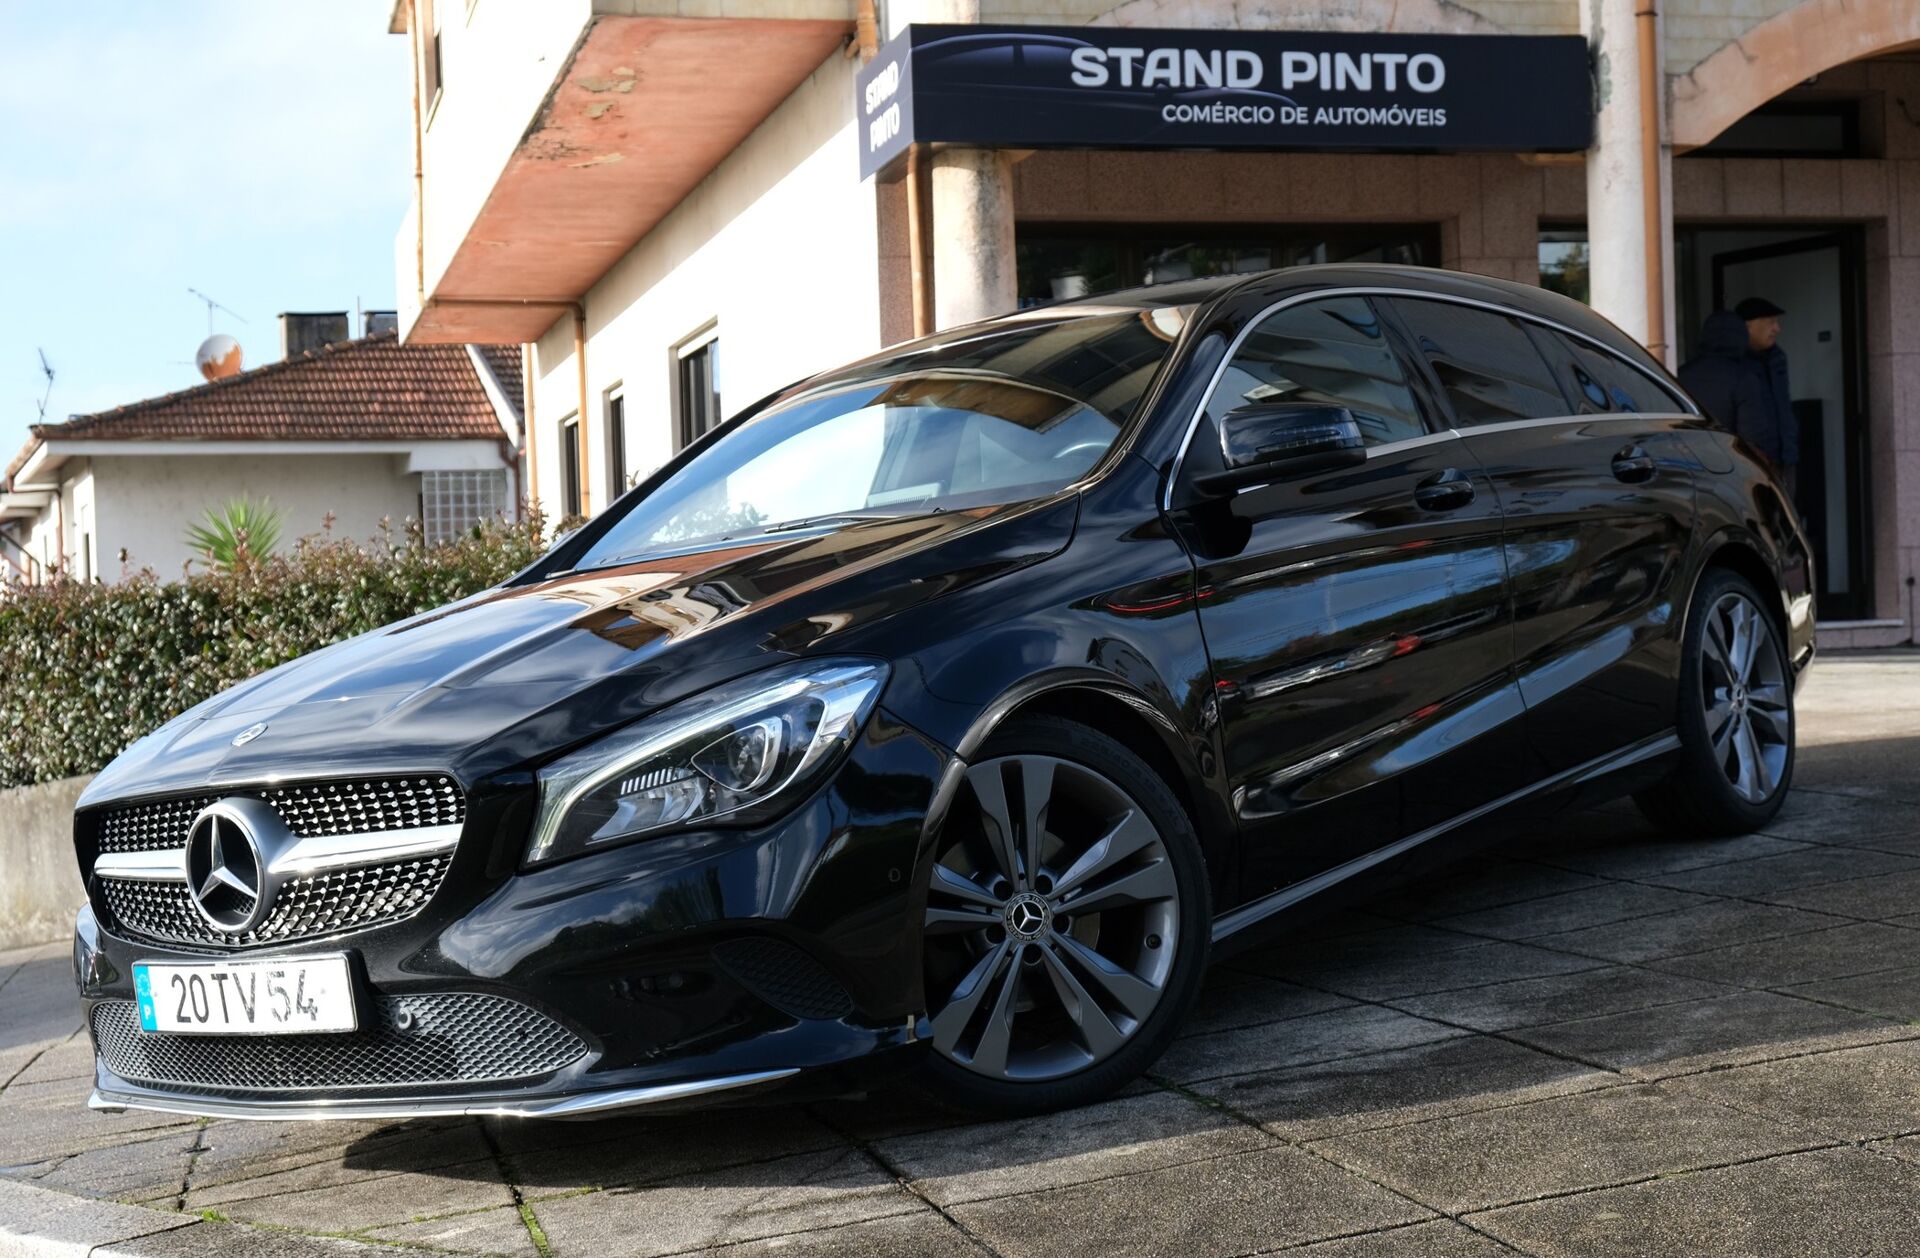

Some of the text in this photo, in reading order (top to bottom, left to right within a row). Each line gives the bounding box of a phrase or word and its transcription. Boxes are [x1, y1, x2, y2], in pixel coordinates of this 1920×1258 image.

[1071, 47, 1446, 93] STAND PINTO
[1162, 101, 1447, 126] COMÉRCIO DE AUTOMÓVEIS
